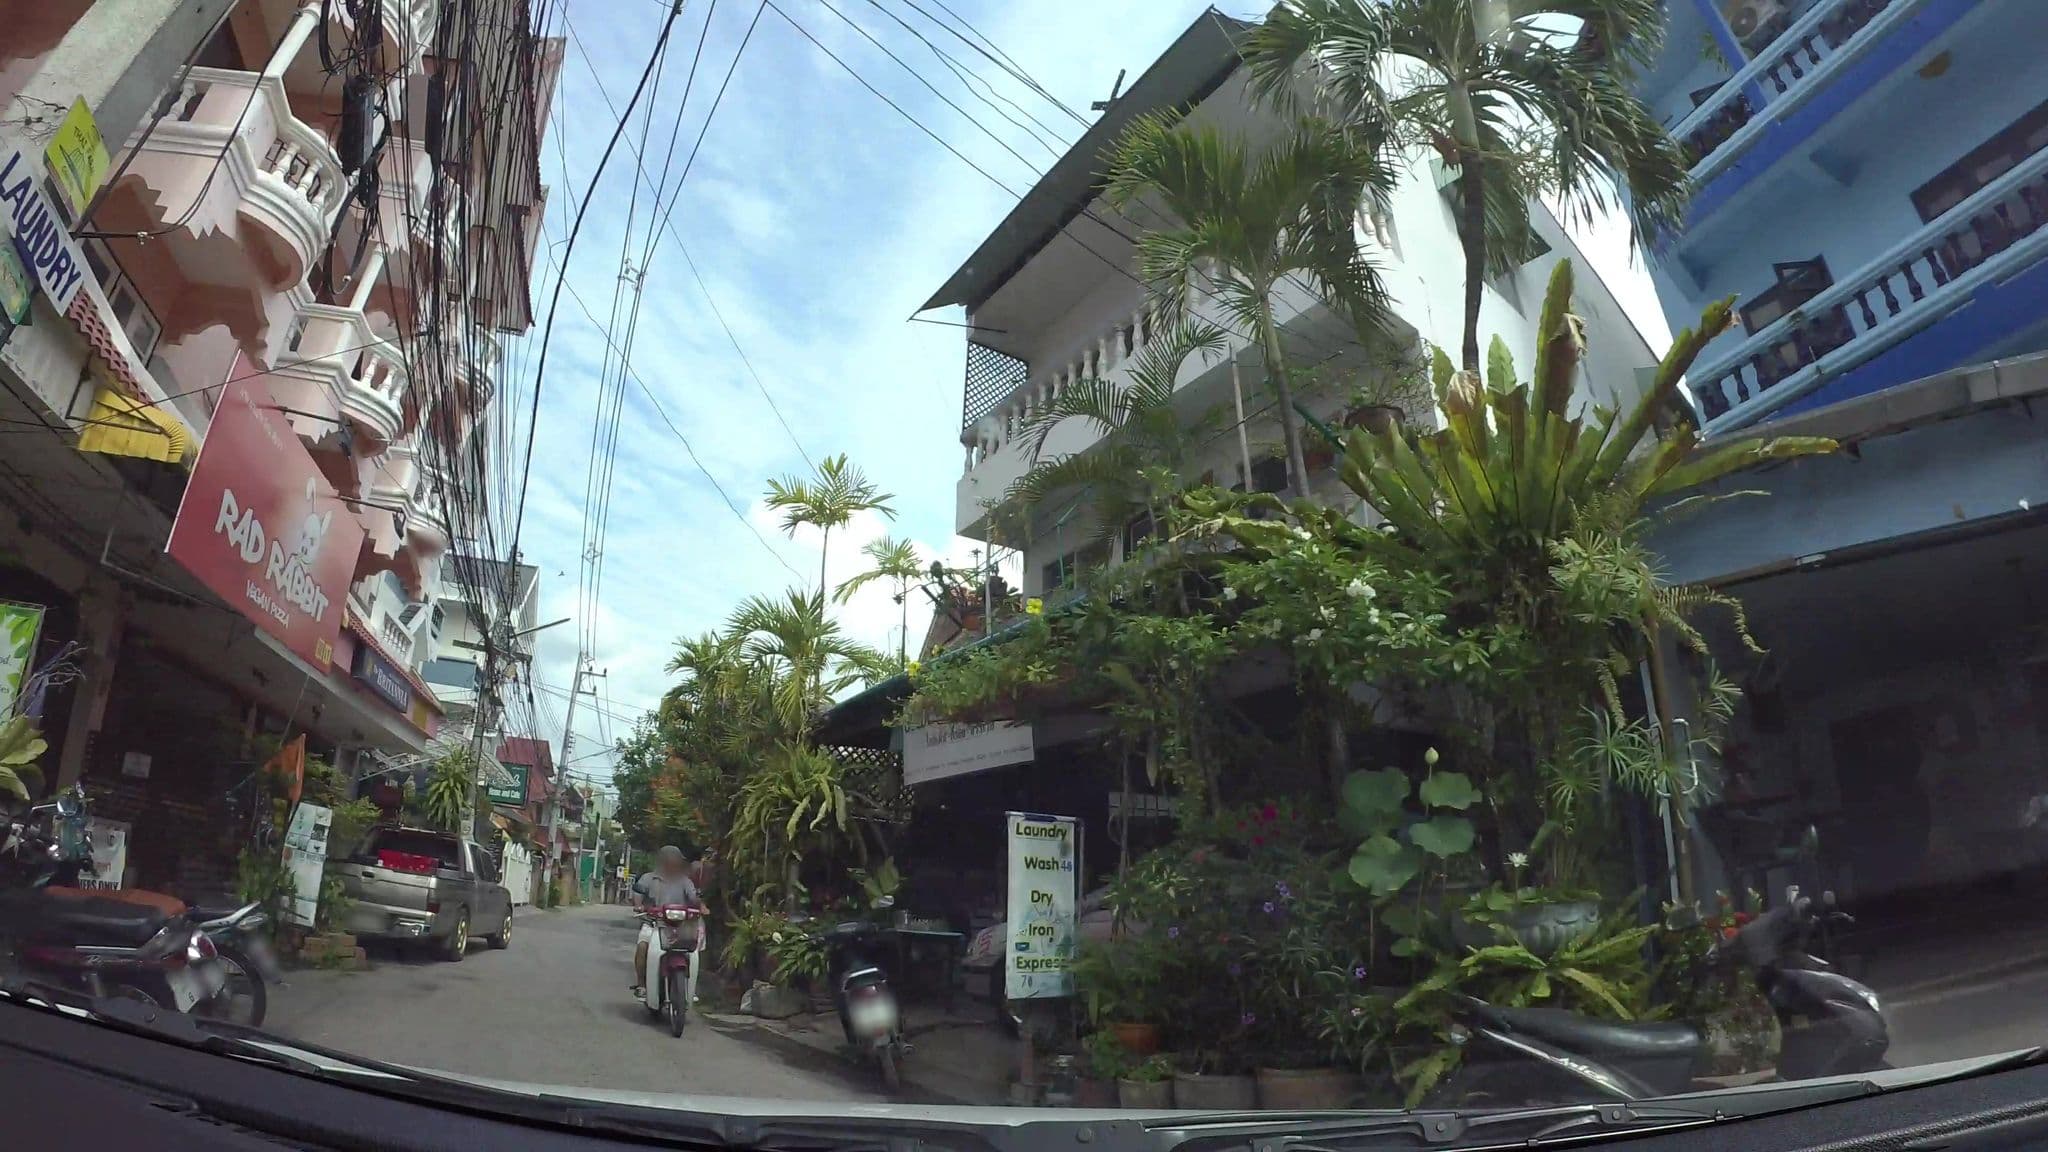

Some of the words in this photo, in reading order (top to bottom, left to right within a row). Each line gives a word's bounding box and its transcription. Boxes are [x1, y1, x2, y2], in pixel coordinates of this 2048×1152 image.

[0, 150, 82, 302] LAUNDRY
[214, 488, 266, 563] RAD
[265, 540, 329, 622] RABBIT
[246, 579, 271, 612] VEGAN
[270, 602, 290, 629] PIZZA
[1016, 822, 1068, 840] Laundry
[1024, 856, 1059, 871] Wash
[1031, 890, 1053, 906] Dry
[1029, 923, 1054, 936] Iron
